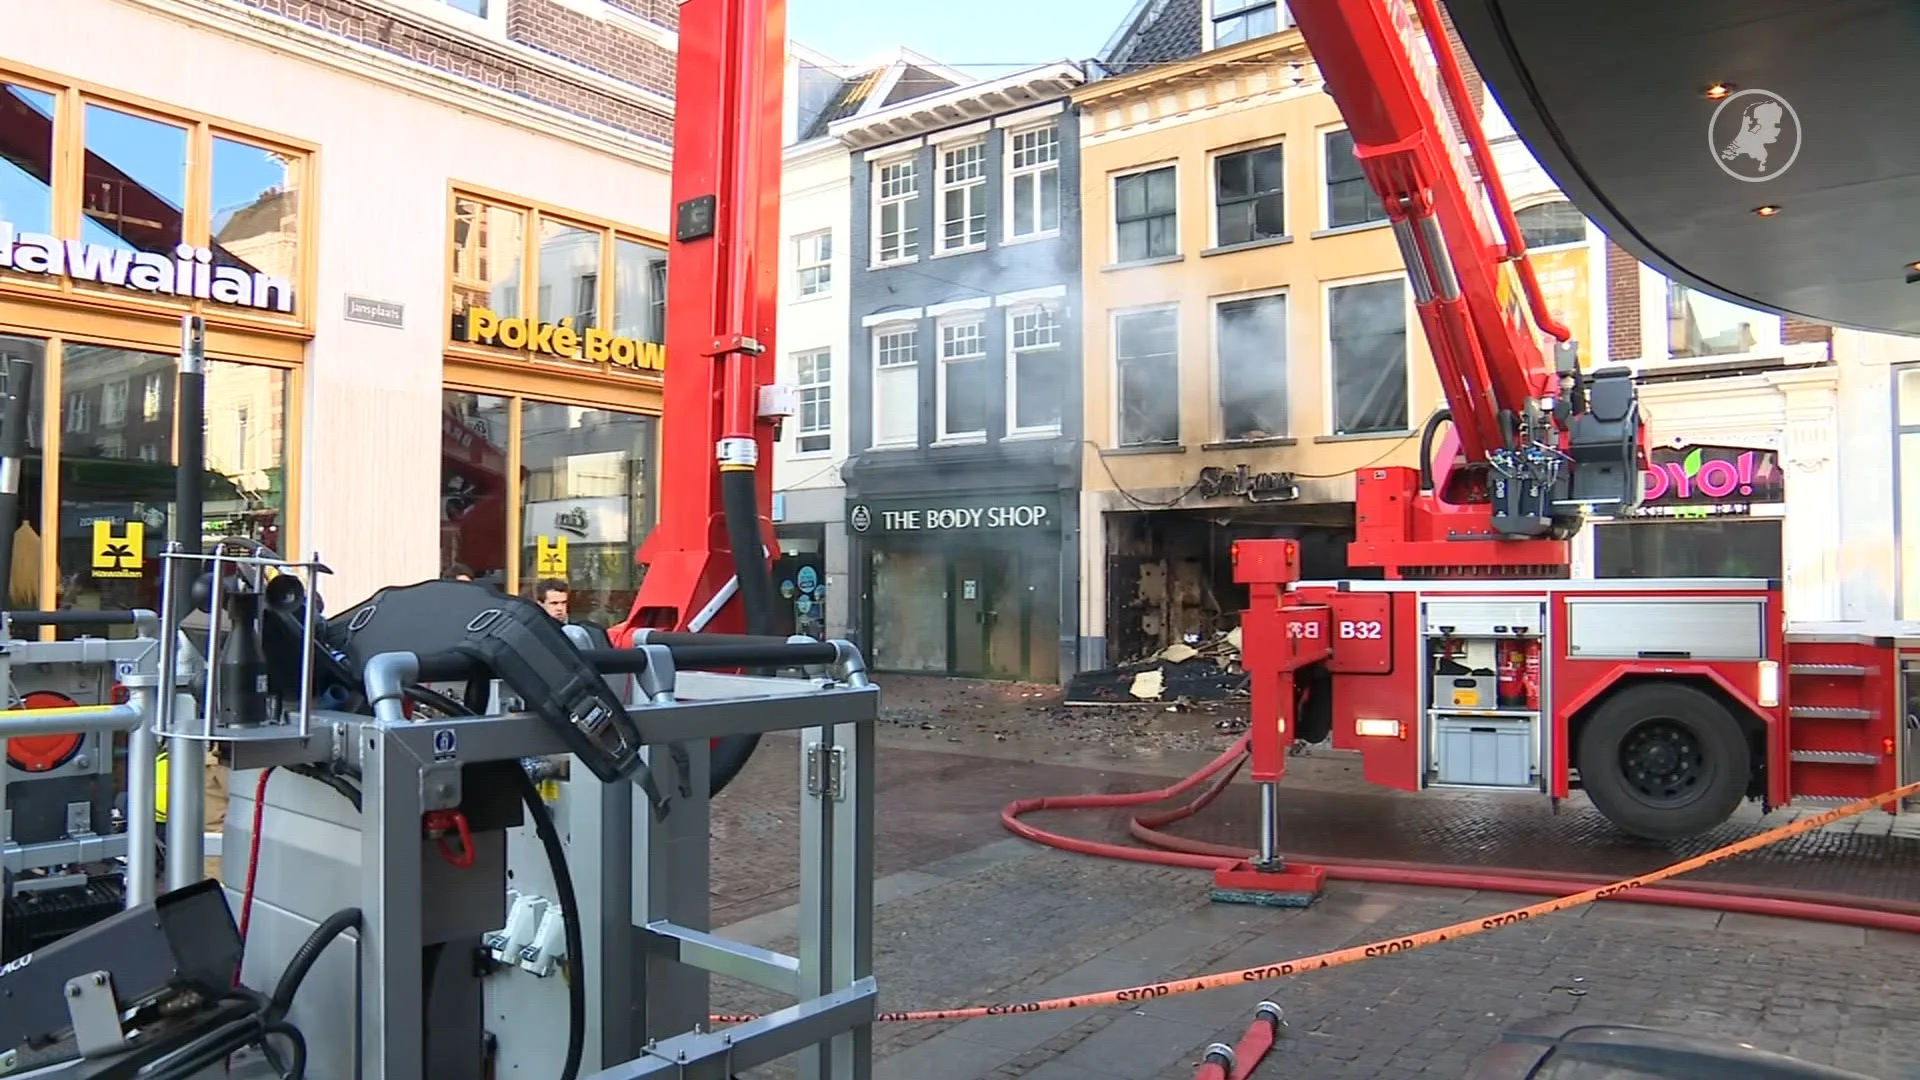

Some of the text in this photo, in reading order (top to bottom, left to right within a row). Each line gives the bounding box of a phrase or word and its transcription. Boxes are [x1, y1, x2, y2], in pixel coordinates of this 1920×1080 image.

[351, 301, 400, 319] Jansplaats
[882, 511, 921, 530] THE
[927, 508, 983, 528] BODY
[988, 505, 1047, 527] SHOP
[1340, 621, 1382, 639] B32
[1365, 939, 1414, 958] STOP
[1243, 964, 1293, 981] STOP
[1116, 985, 1169, 1002] STOP
